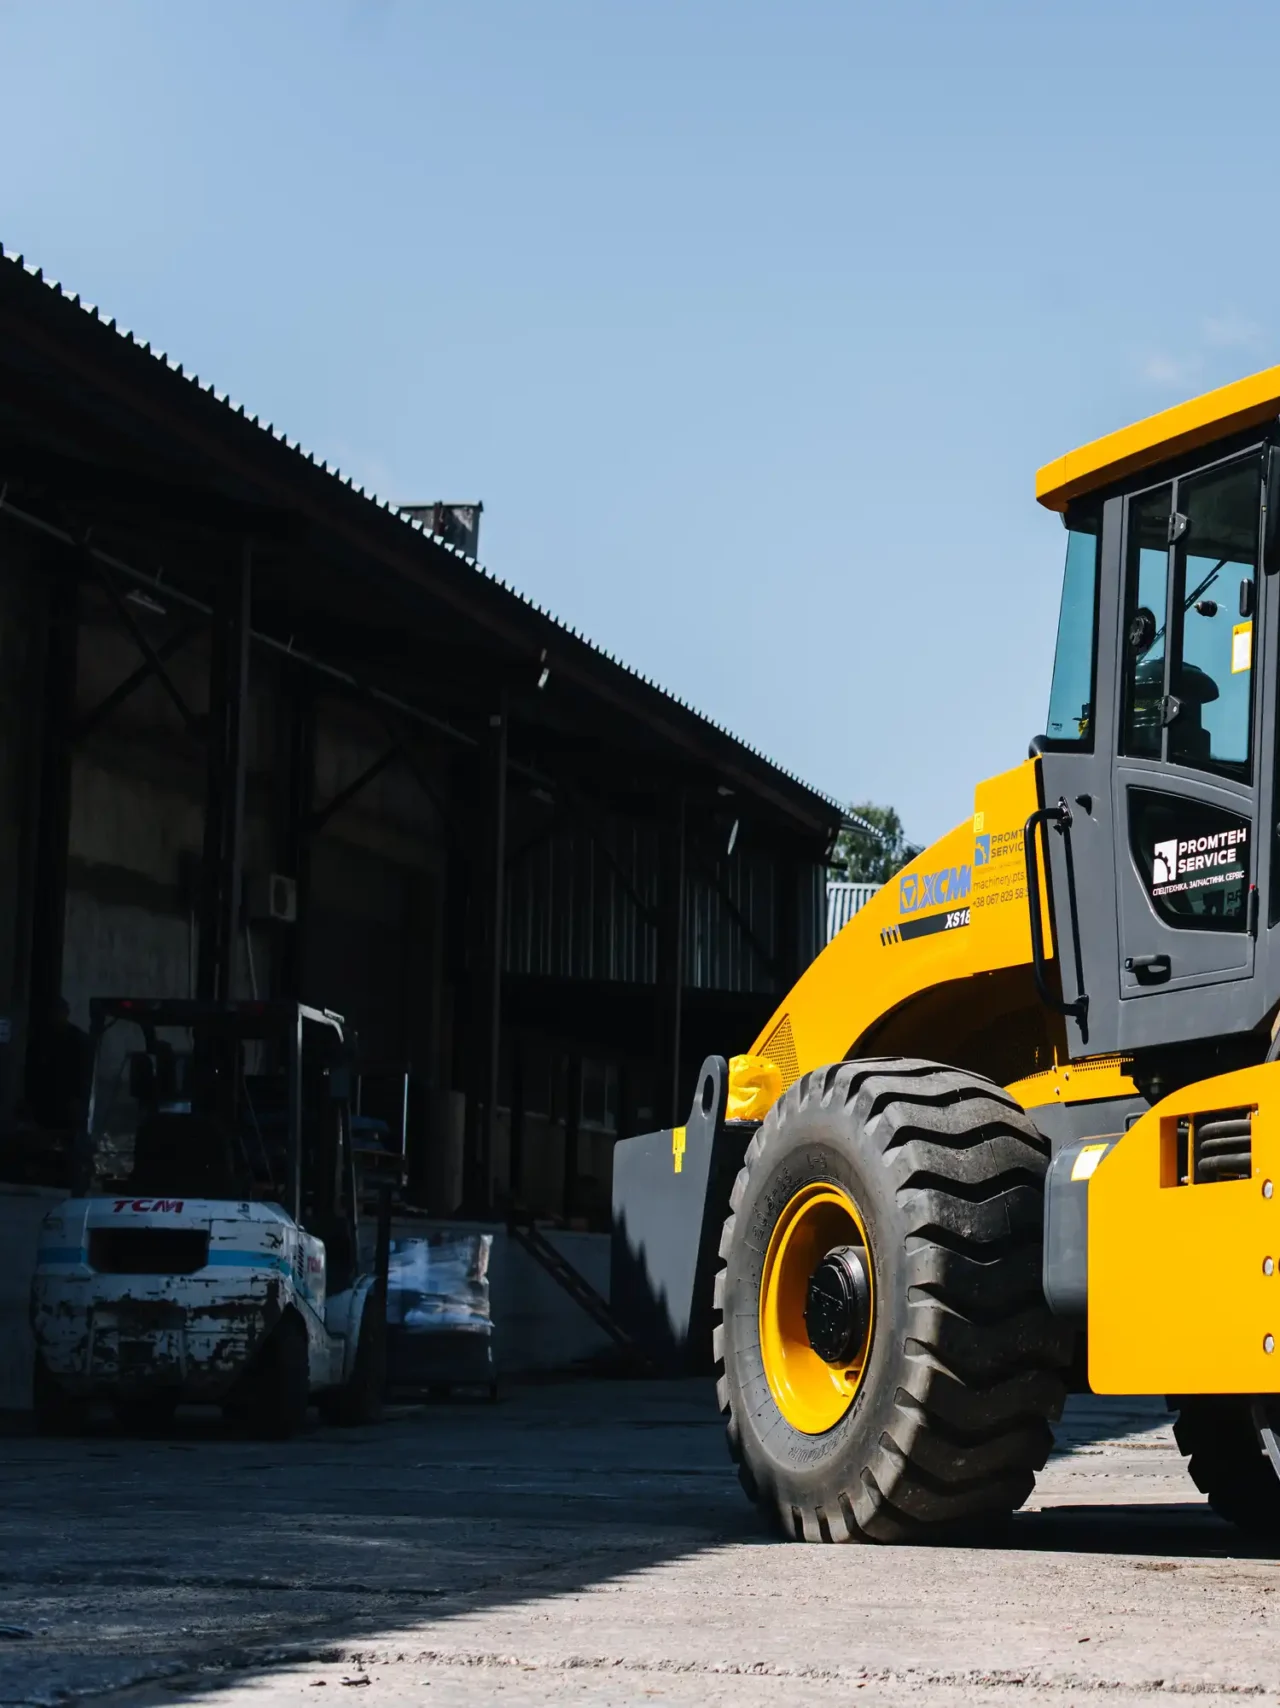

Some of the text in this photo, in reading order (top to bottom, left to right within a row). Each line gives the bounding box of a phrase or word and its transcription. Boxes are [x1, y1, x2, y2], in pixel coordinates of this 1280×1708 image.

[991, 829, 1025, 845] PROMT
[1178, 828, 1247, 856] PROMTEH
[991, 841, 1024, 858] SERVIC
[1177, 848, 1237, 874] SERVICE
[917, 864, 971, 910] XCM
[973, 871, 1025, 891] machinery.pts
[944, 909, 970, 929] XS18
[112, 1199, 184, 1214] TCM
